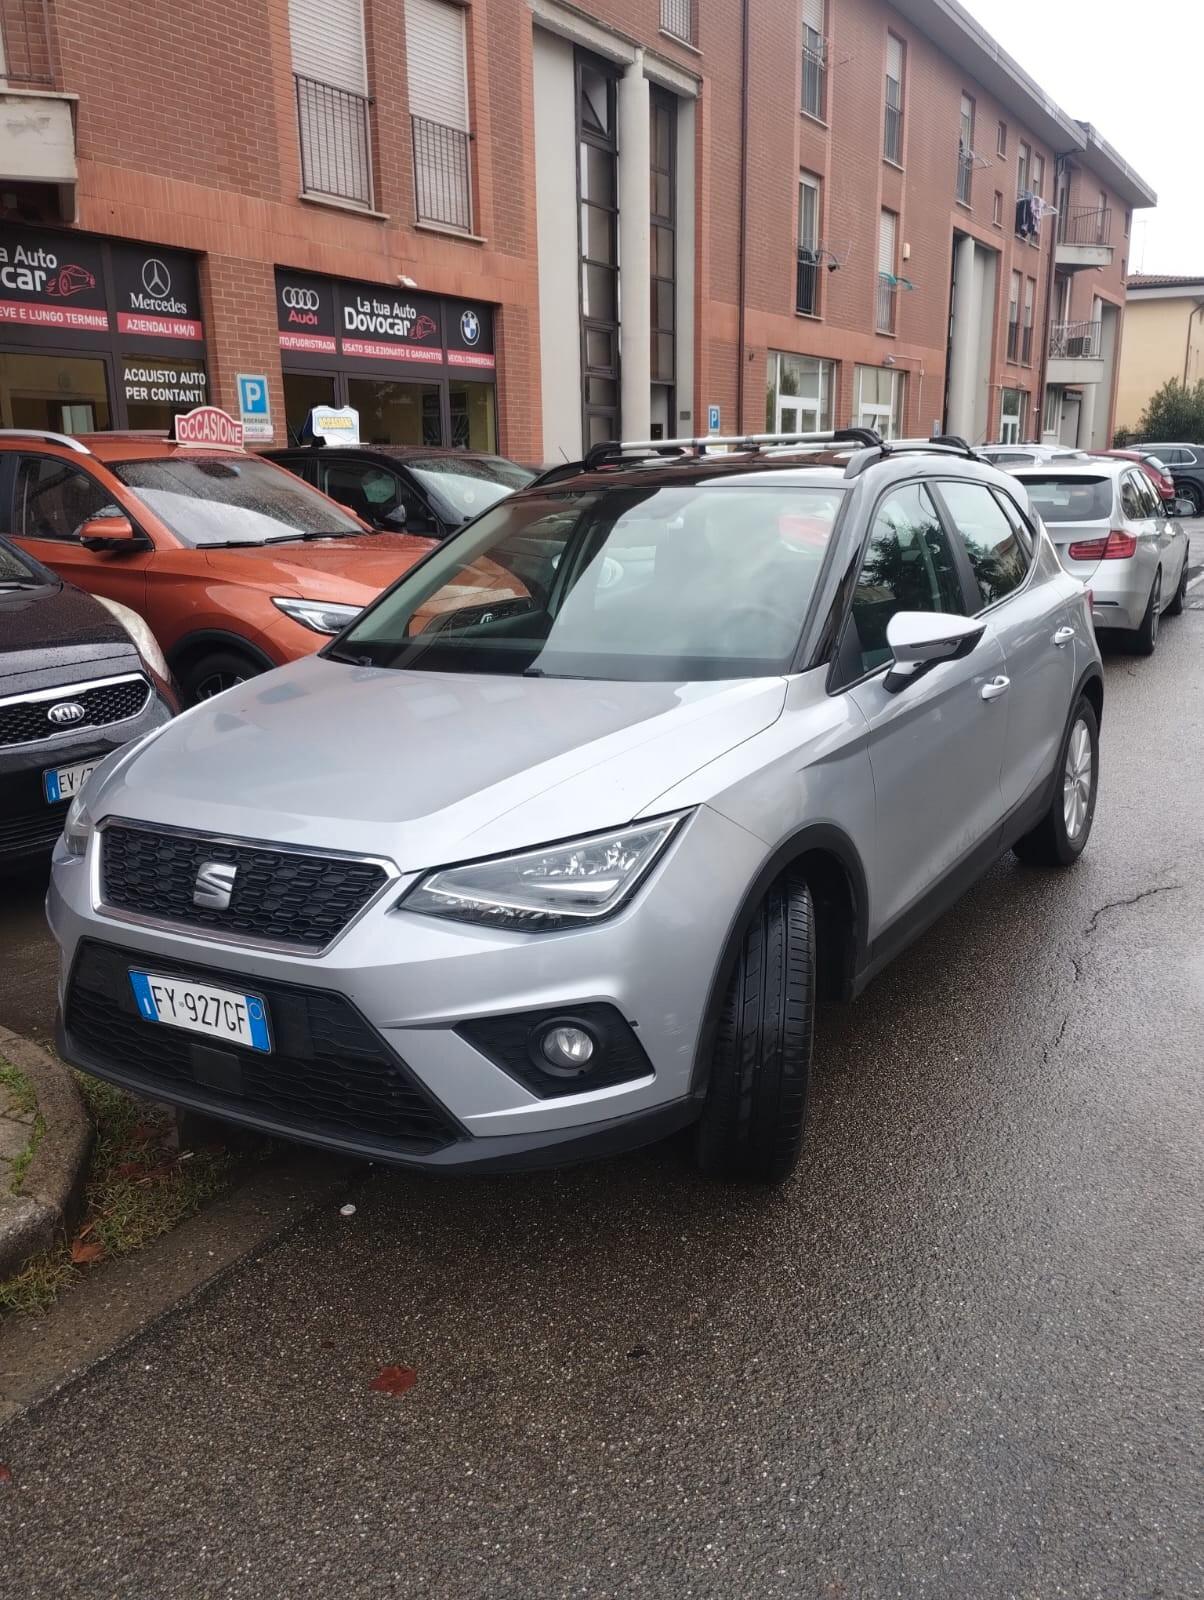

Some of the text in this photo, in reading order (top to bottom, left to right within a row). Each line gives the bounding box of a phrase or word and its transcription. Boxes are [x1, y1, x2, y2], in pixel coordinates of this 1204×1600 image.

[14, 245, 57, 269] Auto
[0, 266, 47, 292] car
[130, 292, 187, 314] Mercedes
[357, 296, 417, 320] La tua Auto
[19, 308, 27, 319] E
[29, 309, 63, 322] LUNGO
[65, 313, 109, 327] TERMINE
[127, 319, 172, 333] AZIENDALI
[287, 310, 318, 325] Audi
[344, 306, 411, 336] Dovocar
[342, 343, 363, 353] USATO
[124, 368, 206, 385] ACQUISTO AUTO
[126, 386, 203, 402] PER CONTANTI
[245, 382, 260, 410] P
[179, 411, 242, 443] OCCASIONE
[711, 410, 718, 428] P
[53, 706, 80, 721] KIA
